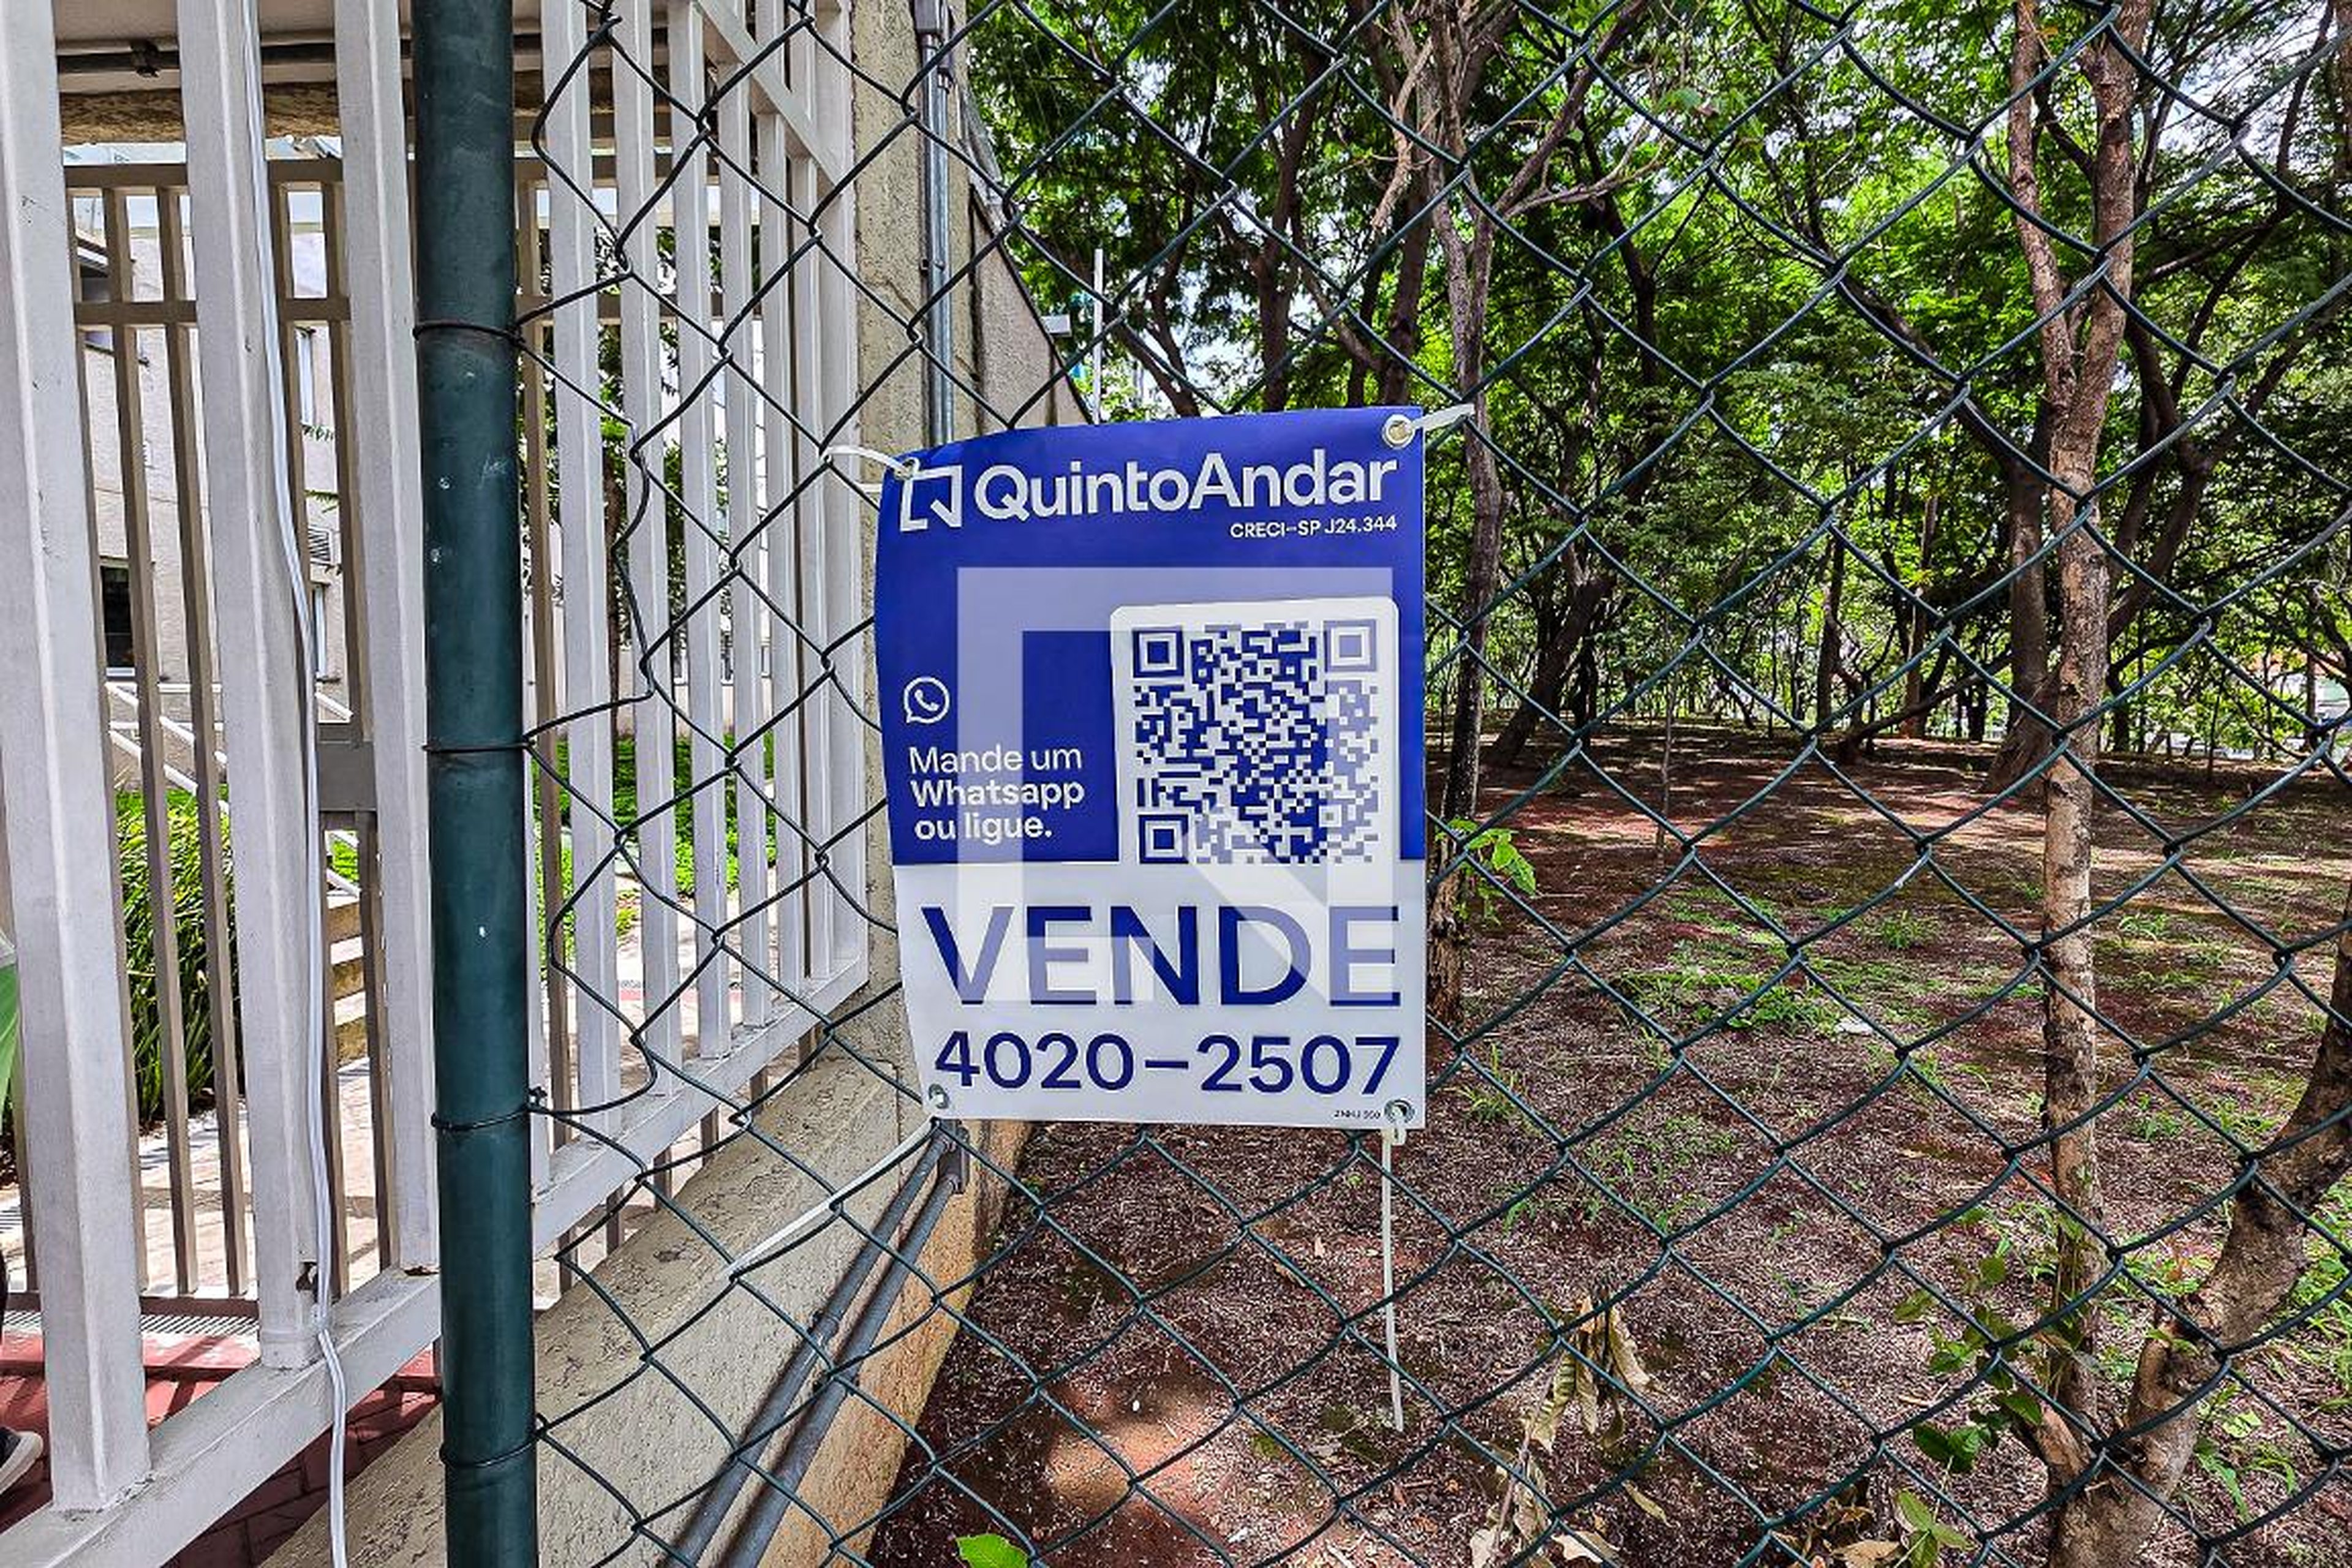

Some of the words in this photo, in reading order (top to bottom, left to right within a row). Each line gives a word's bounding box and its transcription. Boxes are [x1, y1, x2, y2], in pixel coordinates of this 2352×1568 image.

[974, 449, 1398, 521] QuintoAndar
[1230, 520, 1320, 539] CRECI-SP
[1325, 515, 1397, 533] J24.344
[909, 744, 1022, 774] Mande
[1031, 747, 1082, 770] um
[910, 779, 1085, 810] Whatsapp
[914, 819, 956, 840] ou
[963, 812, 1052, 845] ligue.
[921, 905, 1401, 1006] VENDE
[935, 1031, 1401, 1095] 4020-2507
